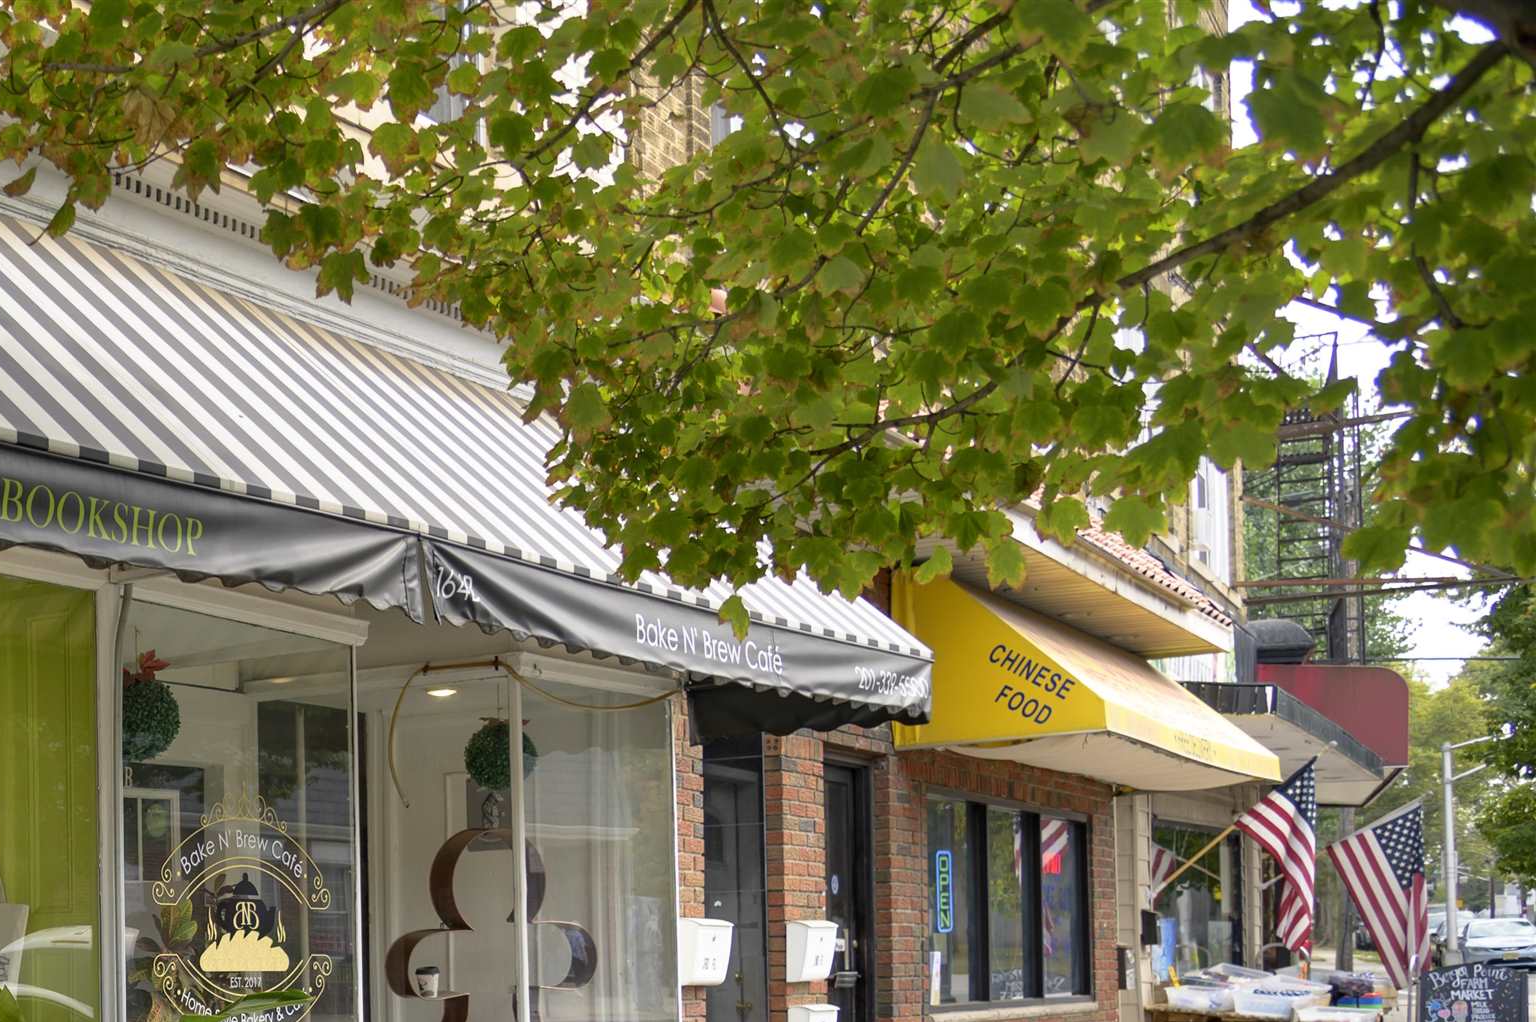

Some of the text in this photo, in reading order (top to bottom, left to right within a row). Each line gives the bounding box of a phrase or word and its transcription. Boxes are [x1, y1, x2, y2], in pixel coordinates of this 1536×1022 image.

[635, 613, 784, 676] Bake N' Brew Café
[989, 643, 1076, 701] CHINESE
[994, 685, 1053, 726] FOOD
[180, 829, 304, 879] Bake N' Brew Café
[939, 856, 951, 929] OPEN
[229, 975, 262, 988] EST. 2017
[1460, 978, 1489, 990] FARM
[1473, 963, 1509, 981] Point
[1450, 989, 1495, 1001] MARKET
[276, 1008, 285, 1021] &
